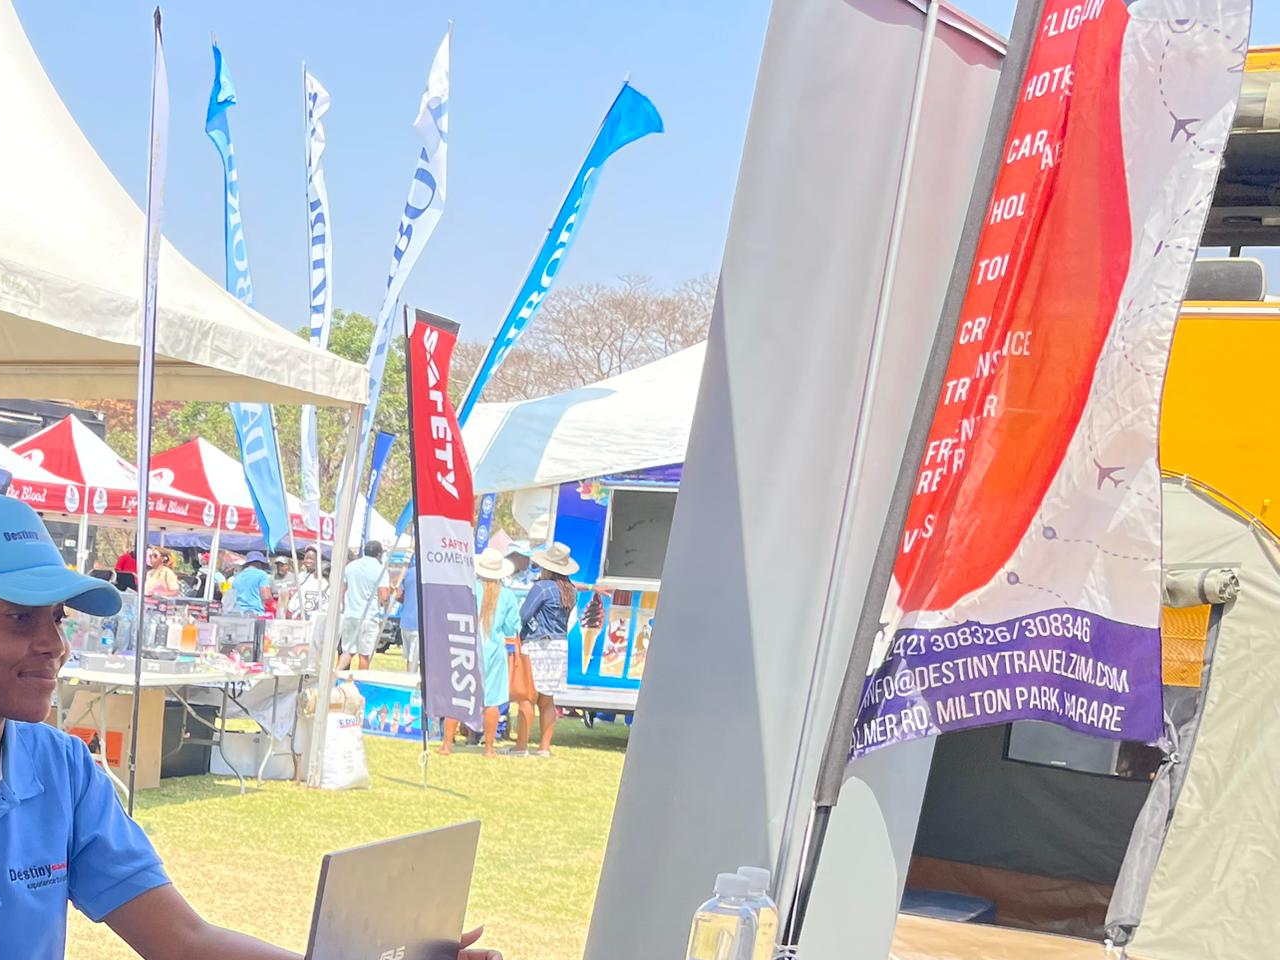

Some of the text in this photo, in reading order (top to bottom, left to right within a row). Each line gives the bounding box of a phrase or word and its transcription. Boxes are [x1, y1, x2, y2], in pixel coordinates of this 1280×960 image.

[424, 327, 459, 500] SAFETY
[20, 487, 47, 503] Blood
[155, 500, 167, 513] the
[167, 499, 189, 516] Blood
[447, 613, 477, 716] FIRST
[936, 689, 1011, 724] MILTON
[1016, 686, 1062, 716] PARK,
[9, 864, 52, 882] Destiny
